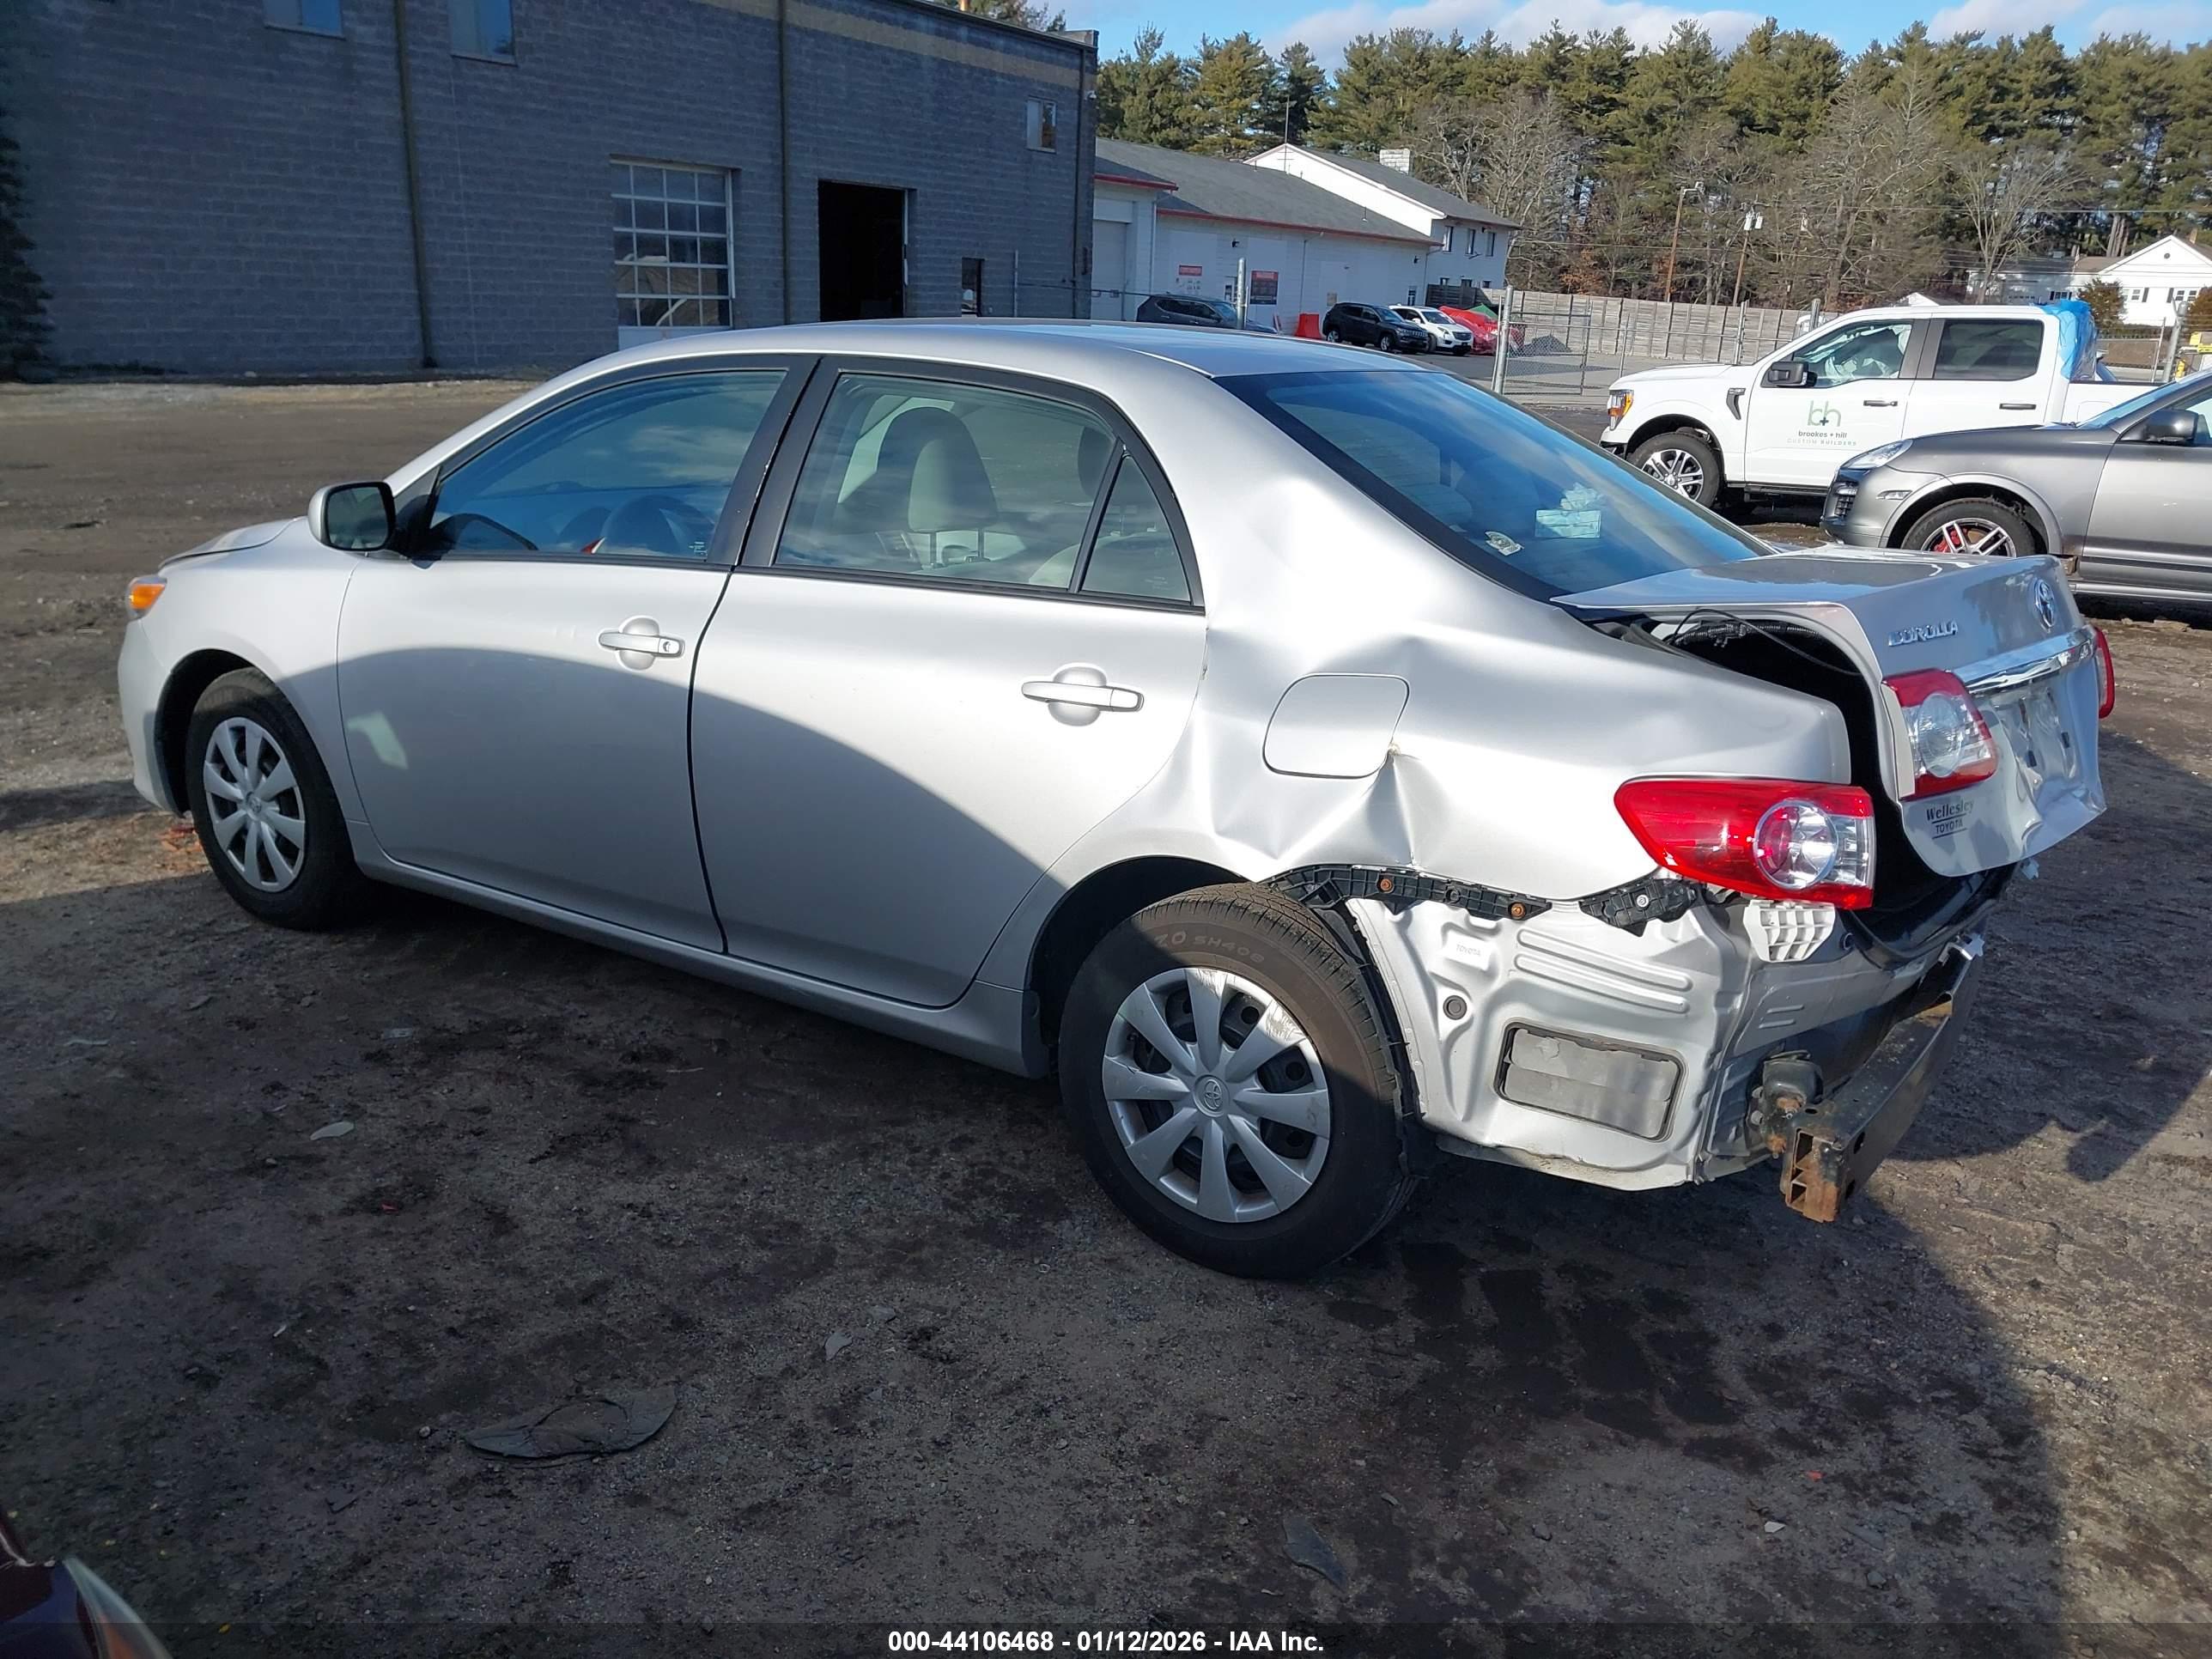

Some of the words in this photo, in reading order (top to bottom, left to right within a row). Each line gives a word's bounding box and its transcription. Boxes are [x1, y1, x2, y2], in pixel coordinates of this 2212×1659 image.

[1887, 620, 1959, 647] COROLLA
[1926, 798, 1974, 821] Wellesley
[1935, 818, 1964, 835] TOYOTA
